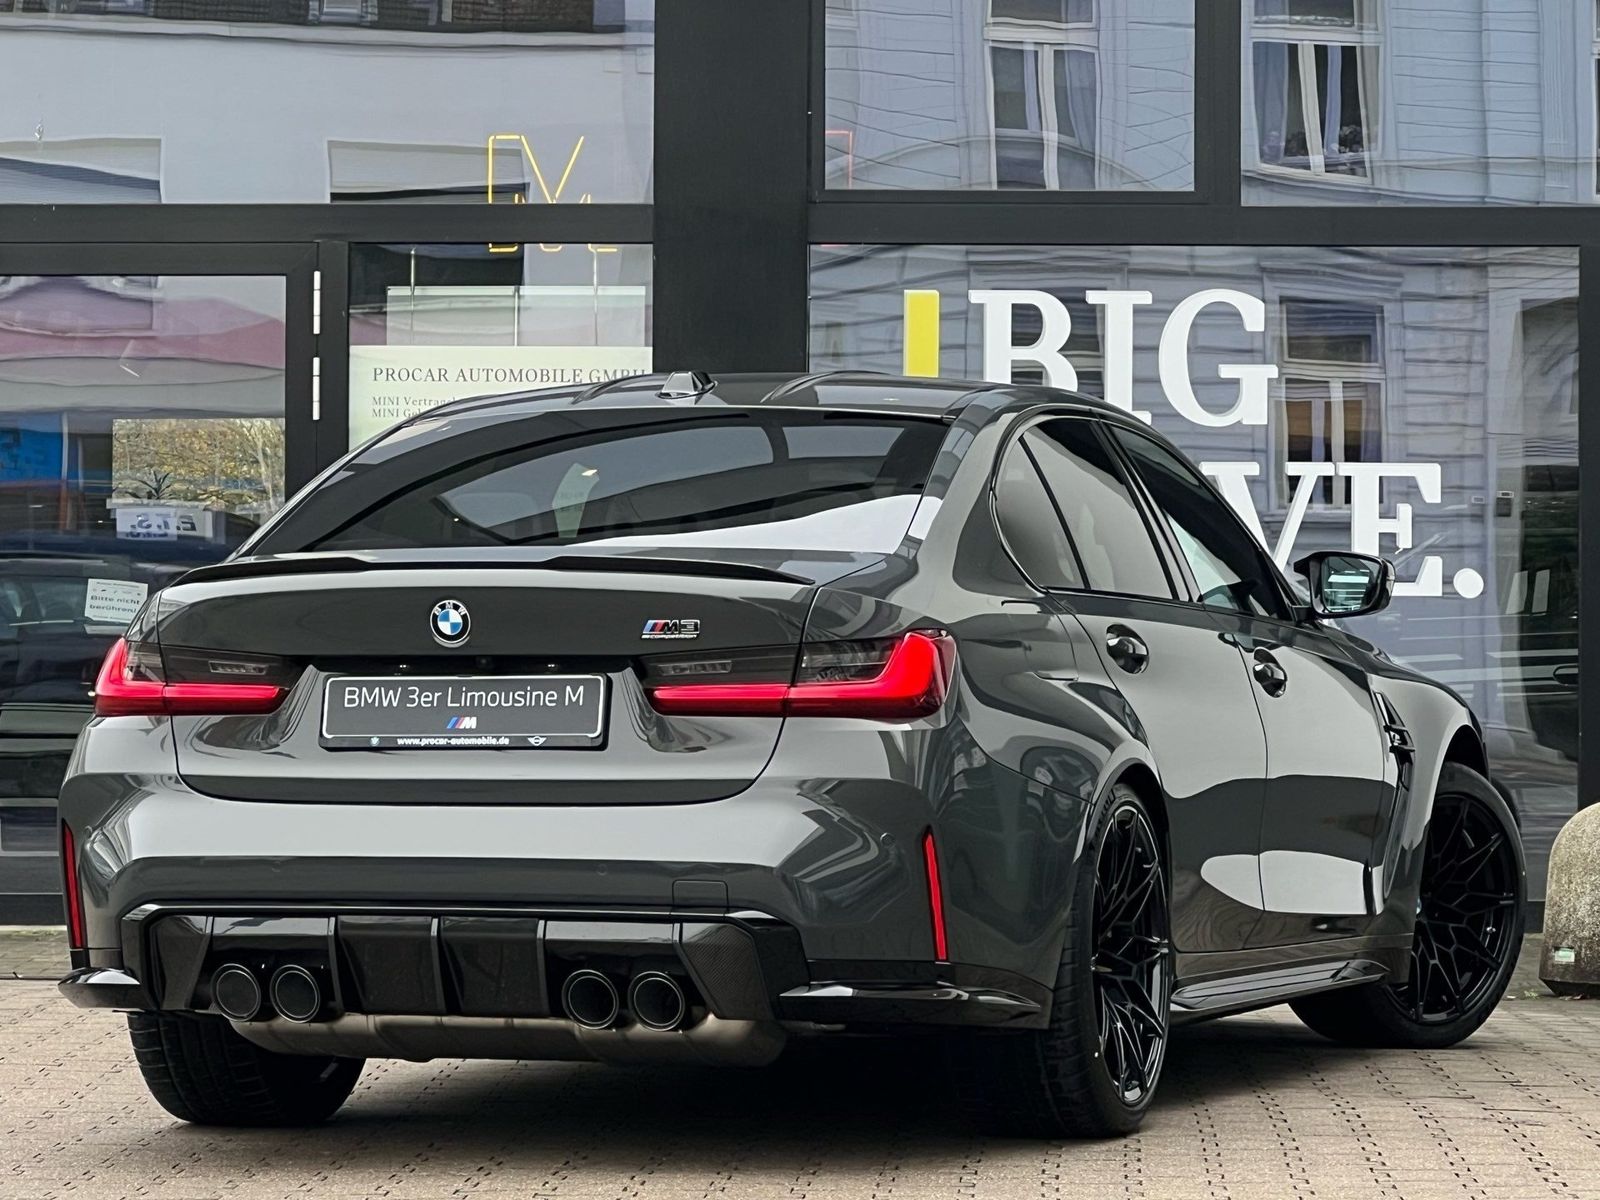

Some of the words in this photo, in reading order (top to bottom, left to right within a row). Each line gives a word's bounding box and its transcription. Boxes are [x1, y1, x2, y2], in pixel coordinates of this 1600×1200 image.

[968, 288, 1279, 428] BIG
[372, 367, 449, 382] PROCAR
[455, 367, 583, 384] AUTOMOBILE
[372, 396, 400, 406] MINI
[372, 408, 400, 418] MINI
[432, 601, 467, 616] BMW
[344, 687, 401, 708] BMW
[406, 687, 443, 708] 3er
[446, 686, 558, 707] Limousine
[565, 685, 584, 706] M
[397, 737, 510, 746] www.procar-automobile.de
